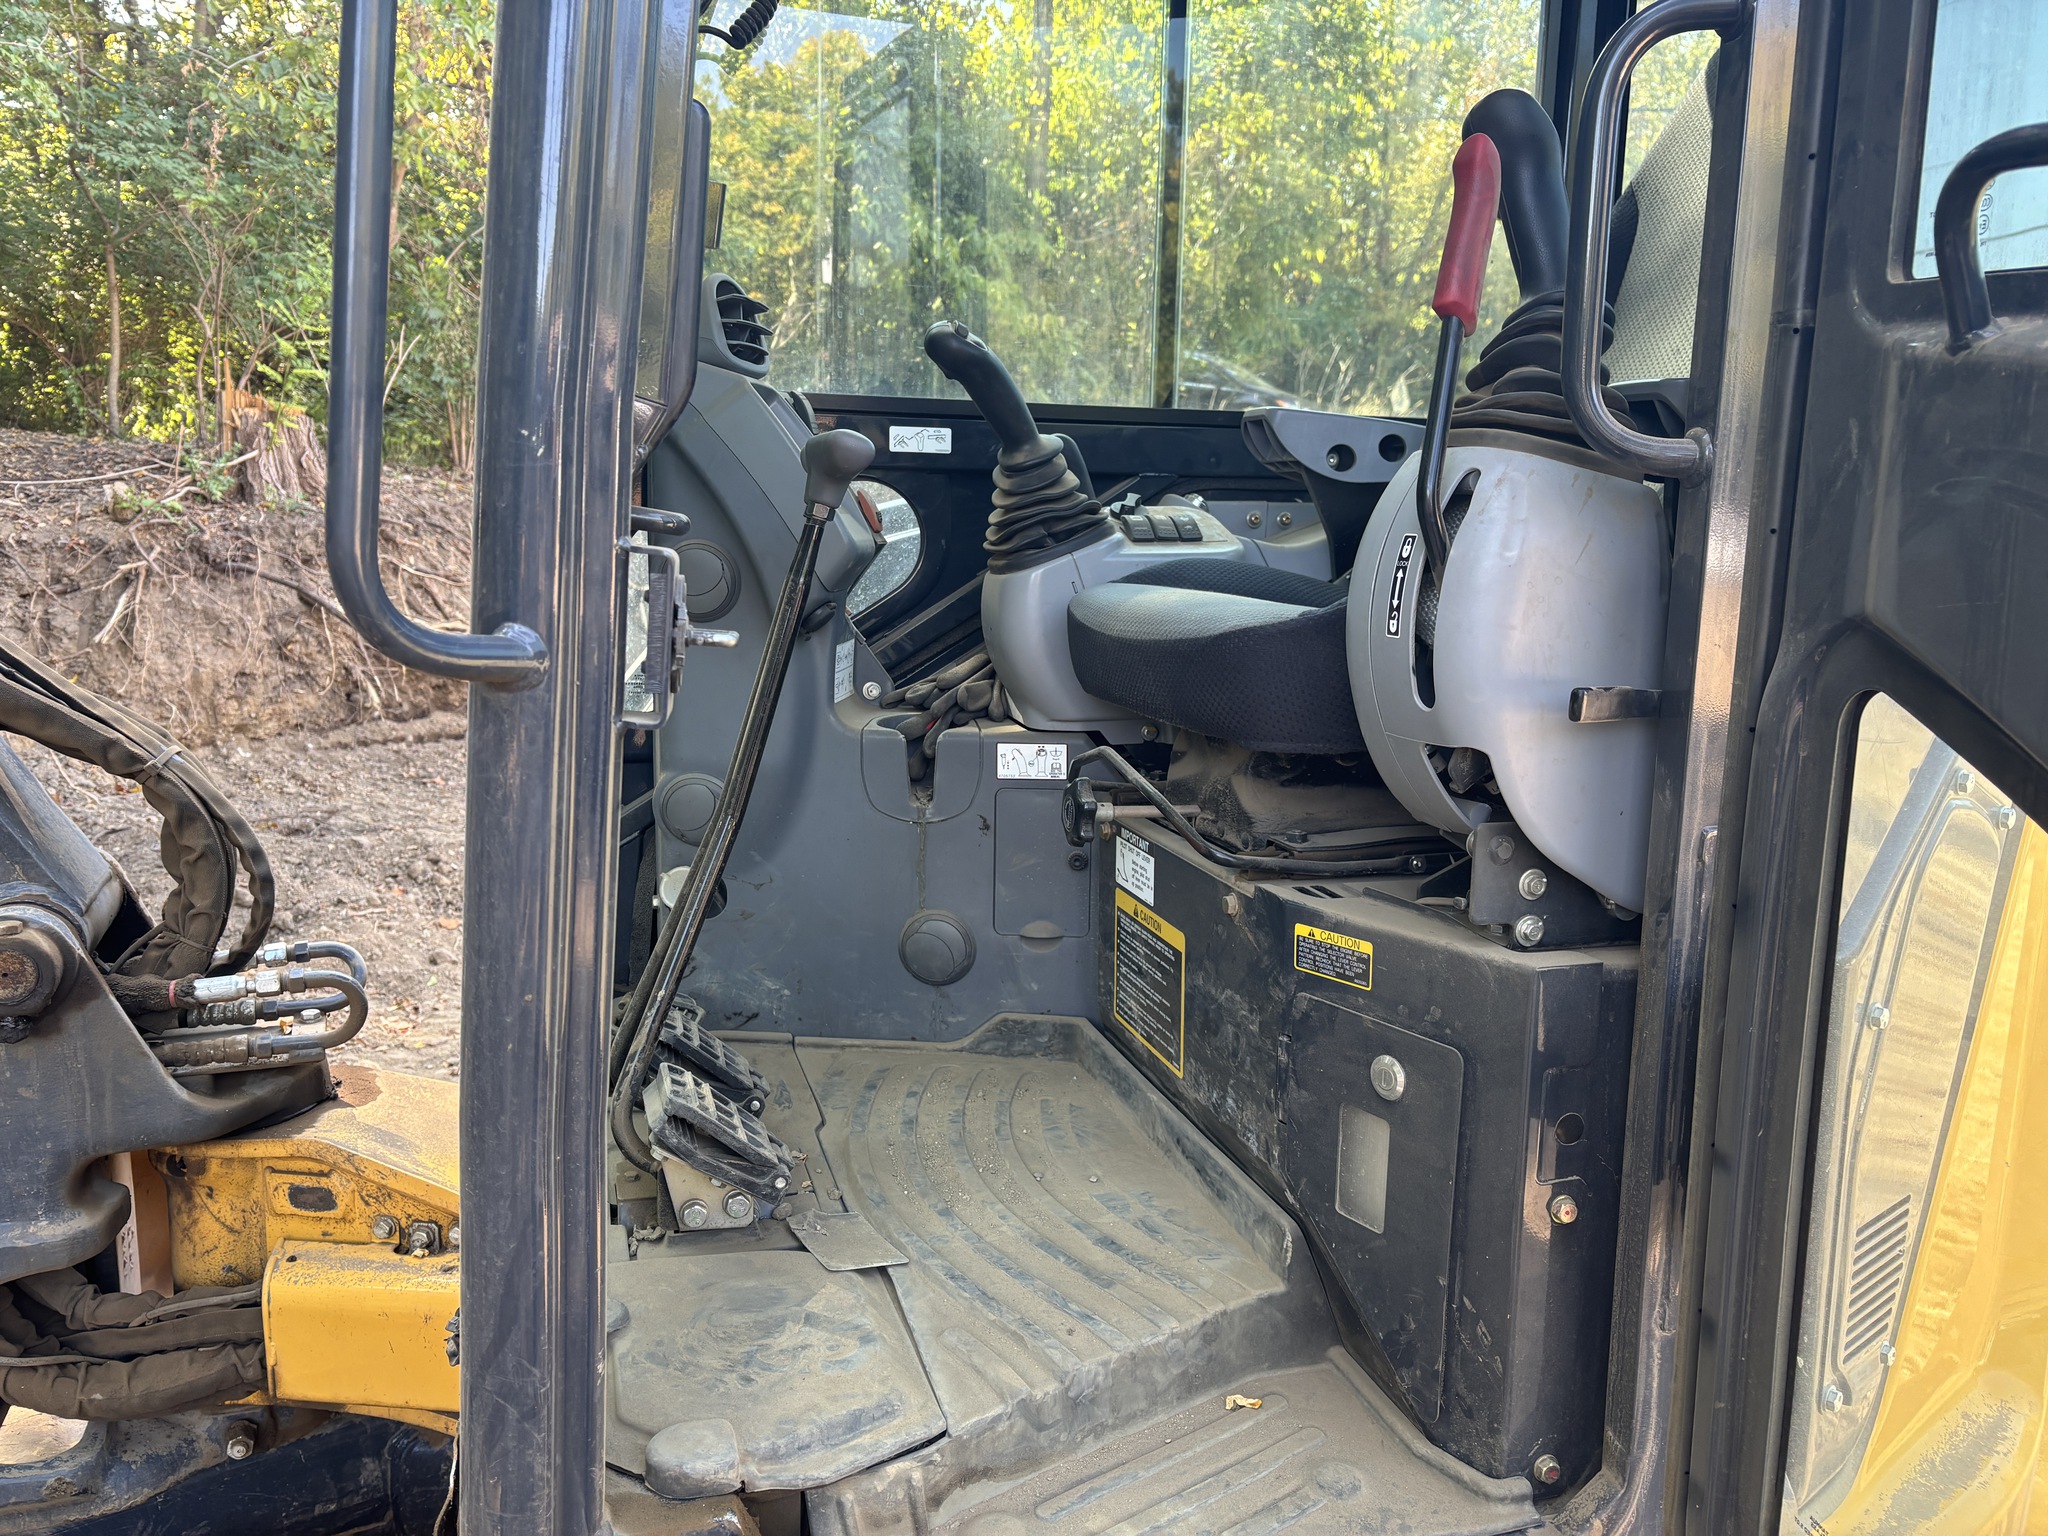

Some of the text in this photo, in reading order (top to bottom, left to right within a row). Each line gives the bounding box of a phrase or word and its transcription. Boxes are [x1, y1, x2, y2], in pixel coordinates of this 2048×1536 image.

[1121, 827, 1149, 853] IMPORTANT
[1140, 910, 1162, 934] CAUTION
[1299, 941, 1318, 950] OPERATING
[1327, 949, 1345, 958] SELECTOR
[1320, 931, 1360, 950] CAUTION
[1310, 950, 1328, 959] CHANGING
[1350, 960, 1366, 970] CONTROL
[1351, 966, 1363, 974] LEVER
